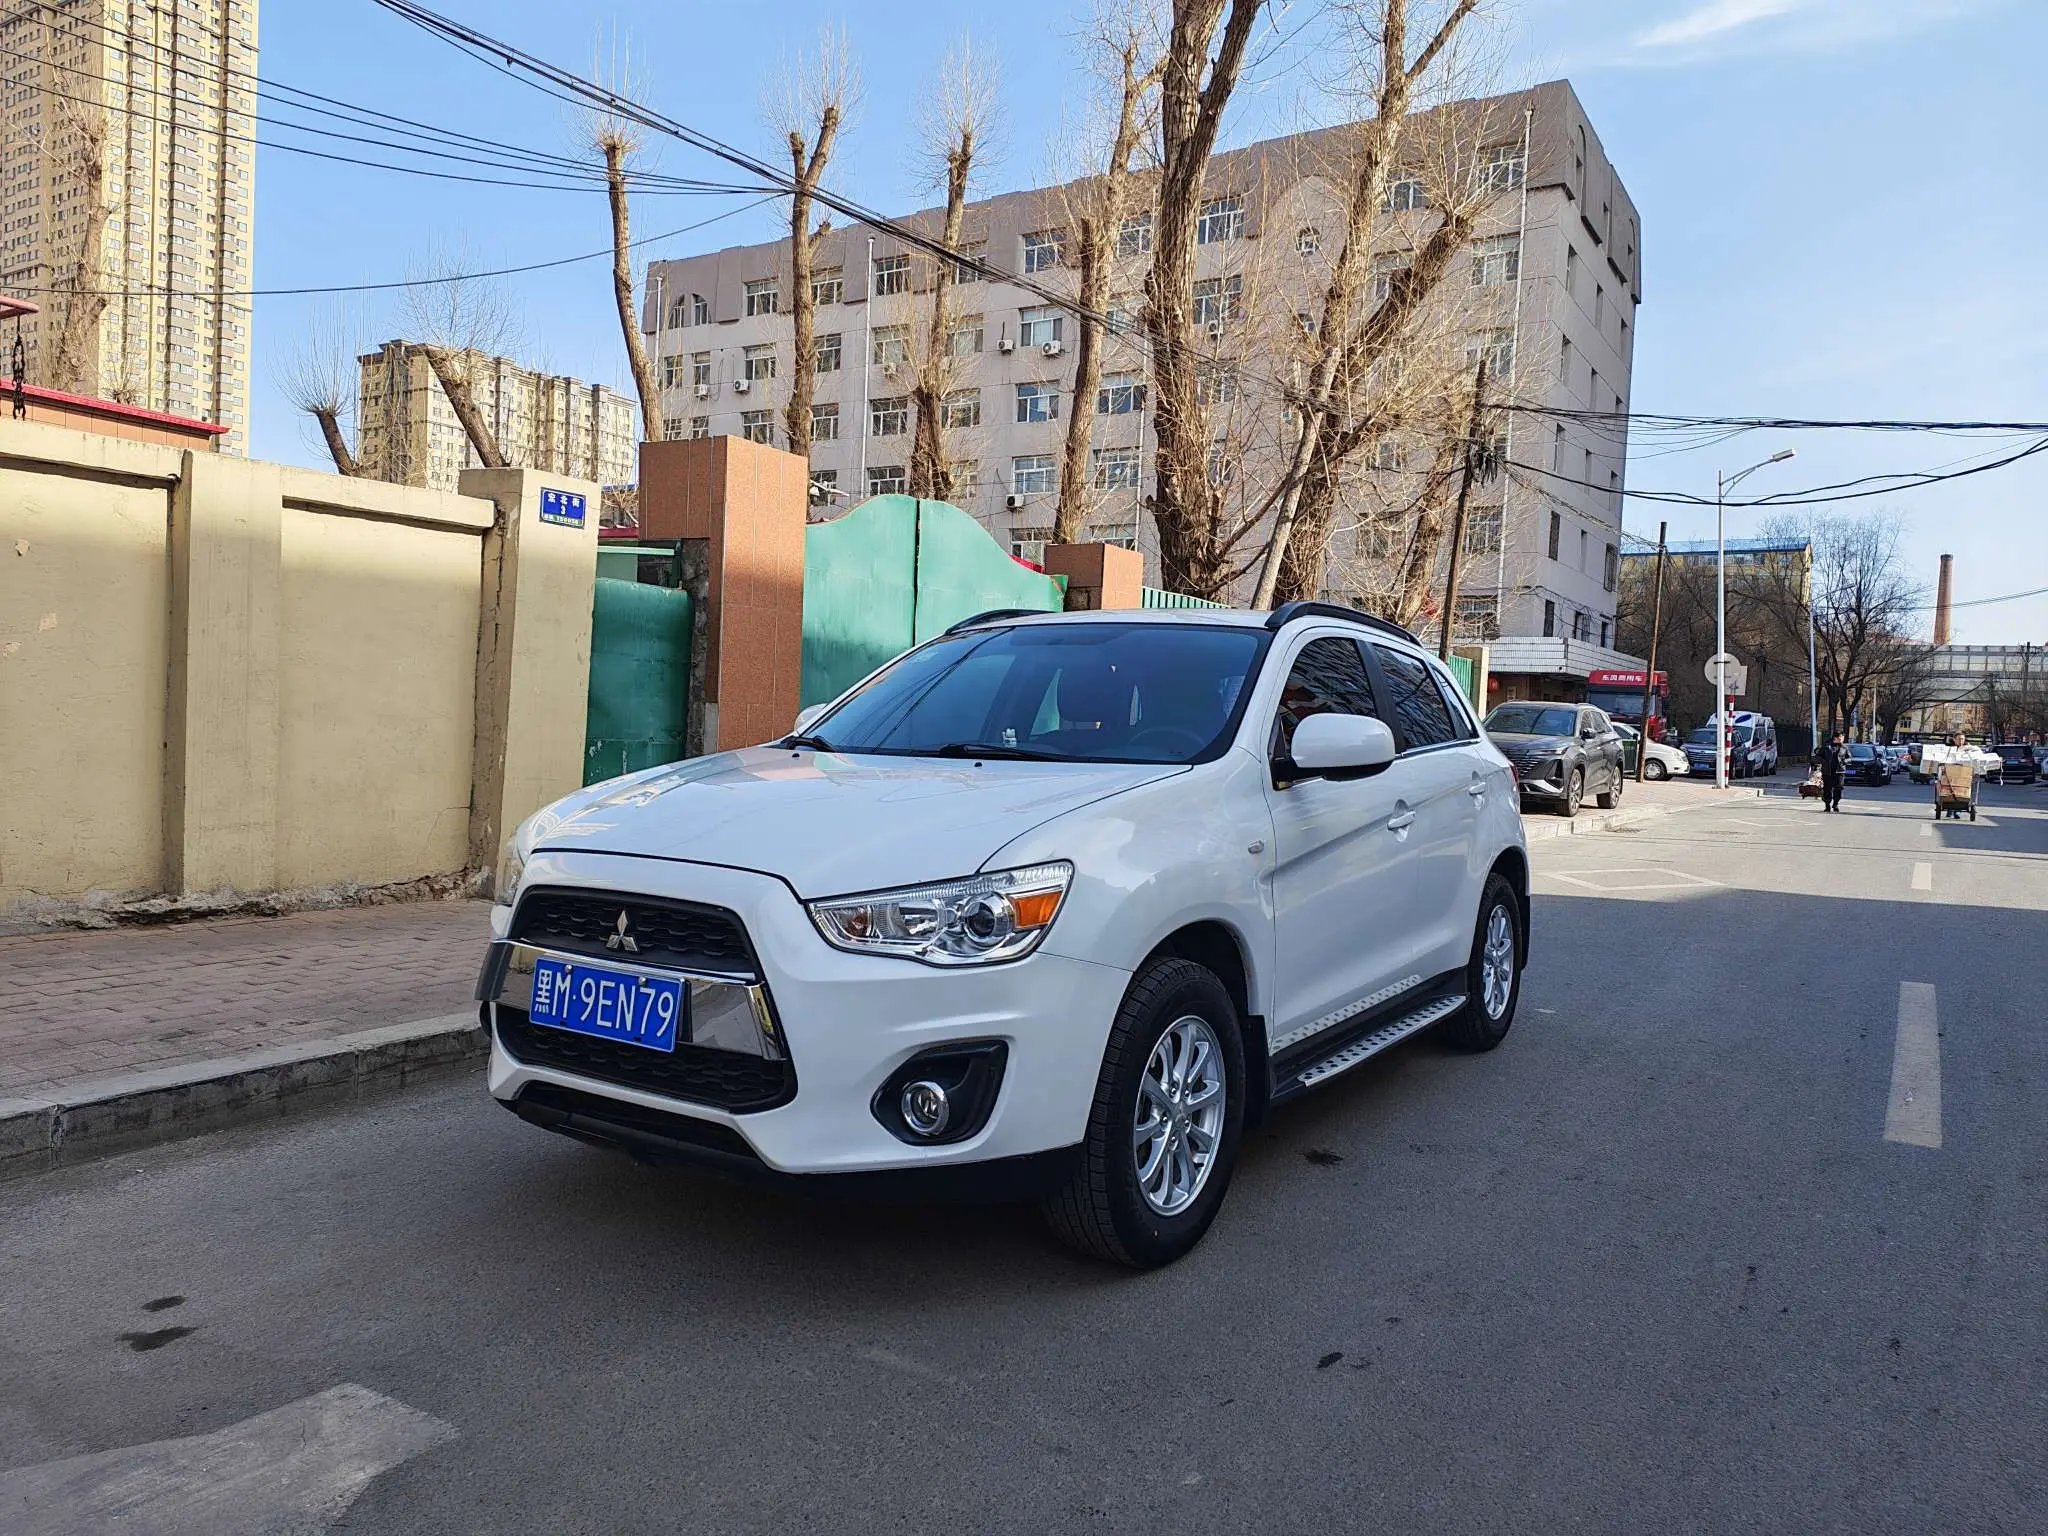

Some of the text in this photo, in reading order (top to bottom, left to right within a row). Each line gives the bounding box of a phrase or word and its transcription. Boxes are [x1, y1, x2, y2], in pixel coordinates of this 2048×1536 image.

[560, 505, 566, 515] 3
[1602, 674, 1643, 682] 东风商用车
